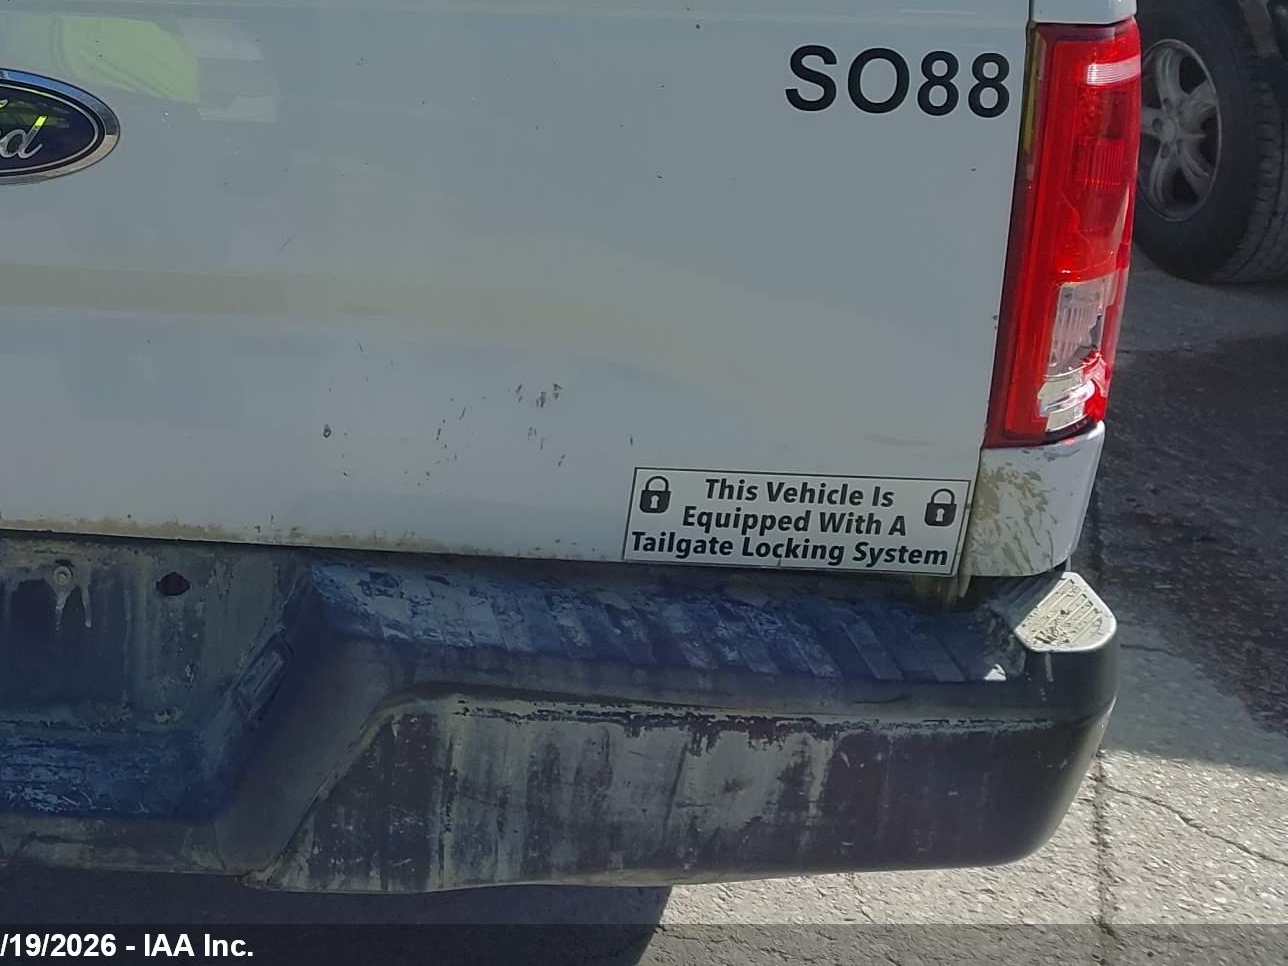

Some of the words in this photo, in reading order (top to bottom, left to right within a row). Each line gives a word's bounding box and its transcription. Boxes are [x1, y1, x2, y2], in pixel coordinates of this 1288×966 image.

[785, 44, 1010, 118] SO88
[705, 478, 759, 502] This
[767, 481, 863, 507] Vehicle
[872, 486, 894, 508] Is
[682, 506, 811, 536] Equipped
[818, 511, 882, 535] With
[888, 515, 906, 536] A
[631, 531, 734, 559] Tailgate
[741, 537, 845, 564] Locking
[851, 542, 948, 567] System
